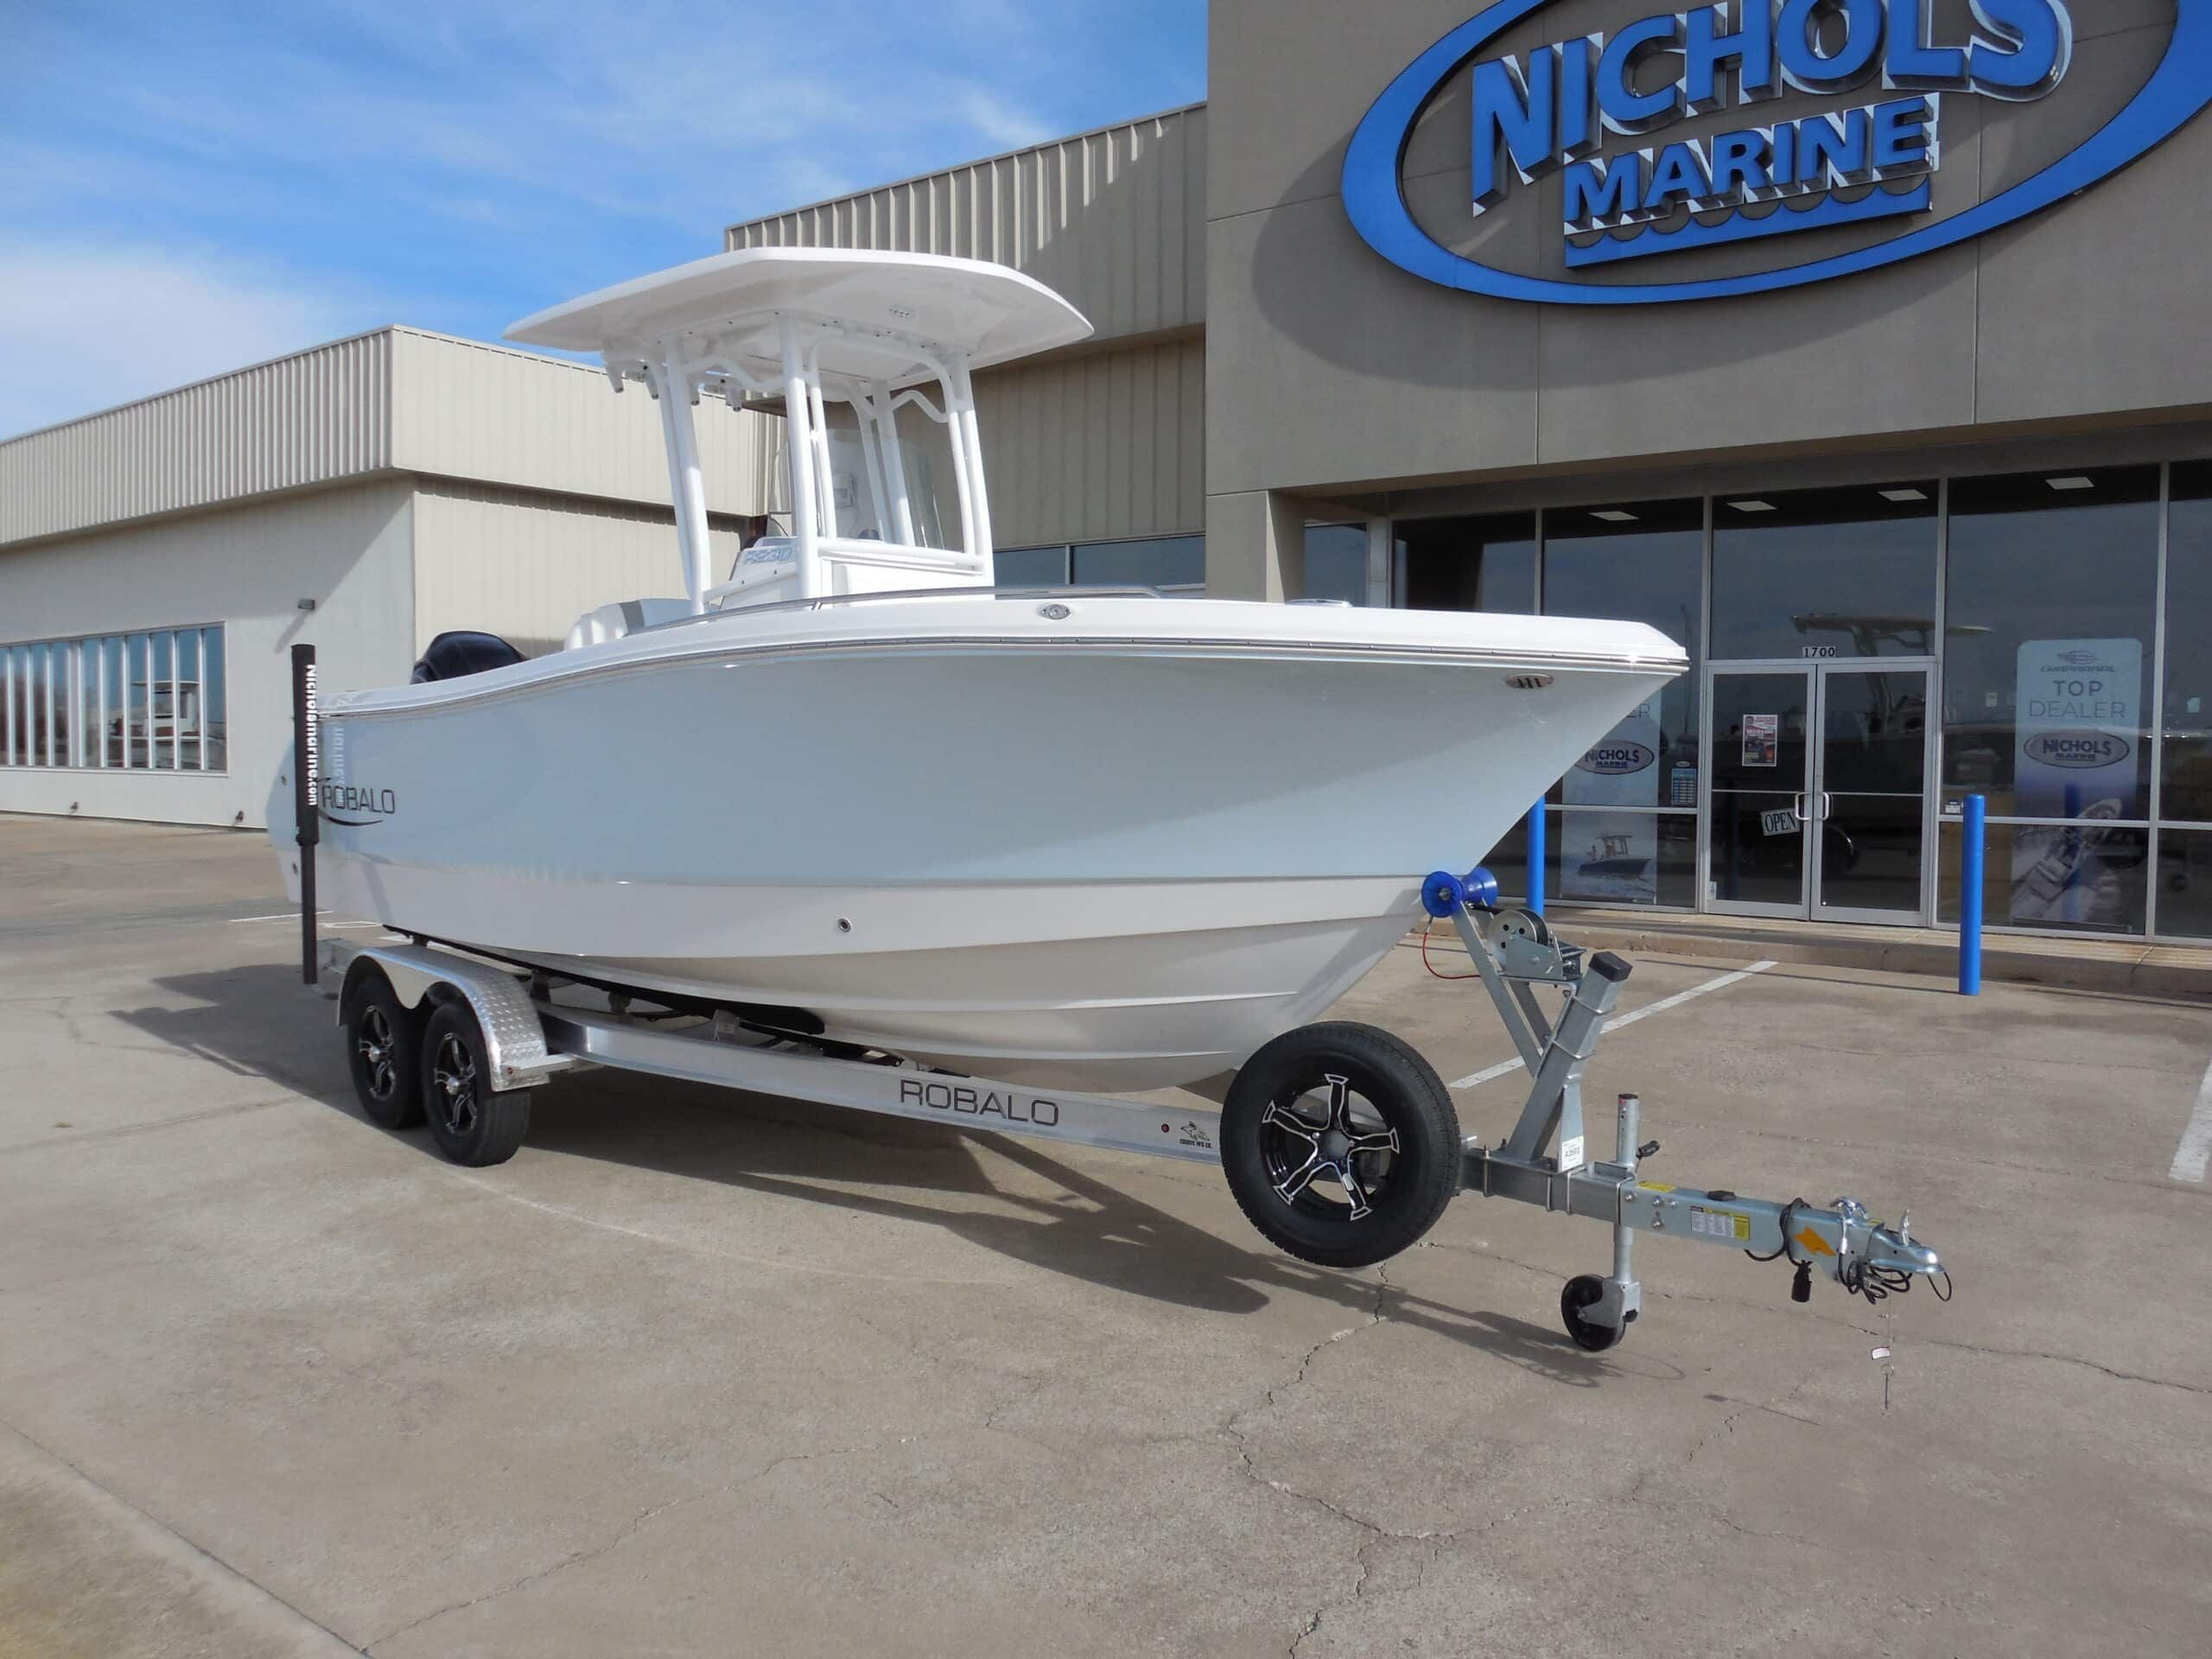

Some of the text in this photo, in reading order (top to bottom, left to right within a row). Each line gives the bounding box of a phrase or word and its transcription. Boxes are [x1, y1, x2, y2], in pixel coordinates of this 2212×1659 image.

[1472, 0, 2070, 216] NICHOLS
[1564, 93, 1939, 234] MARINE
[1804, 646, 1835, 657] 1700
[2053, 679, 2102, 696] TOP
[2029, 700, 2126, 719] DEALER
[2042, 739, 2111, 756] NICHOLS
[321, 785, 395, 815] ROBALO
[1764, 810, 1797, 832] OPEN
[900, 1079, 1059, 1127] ROBALO
